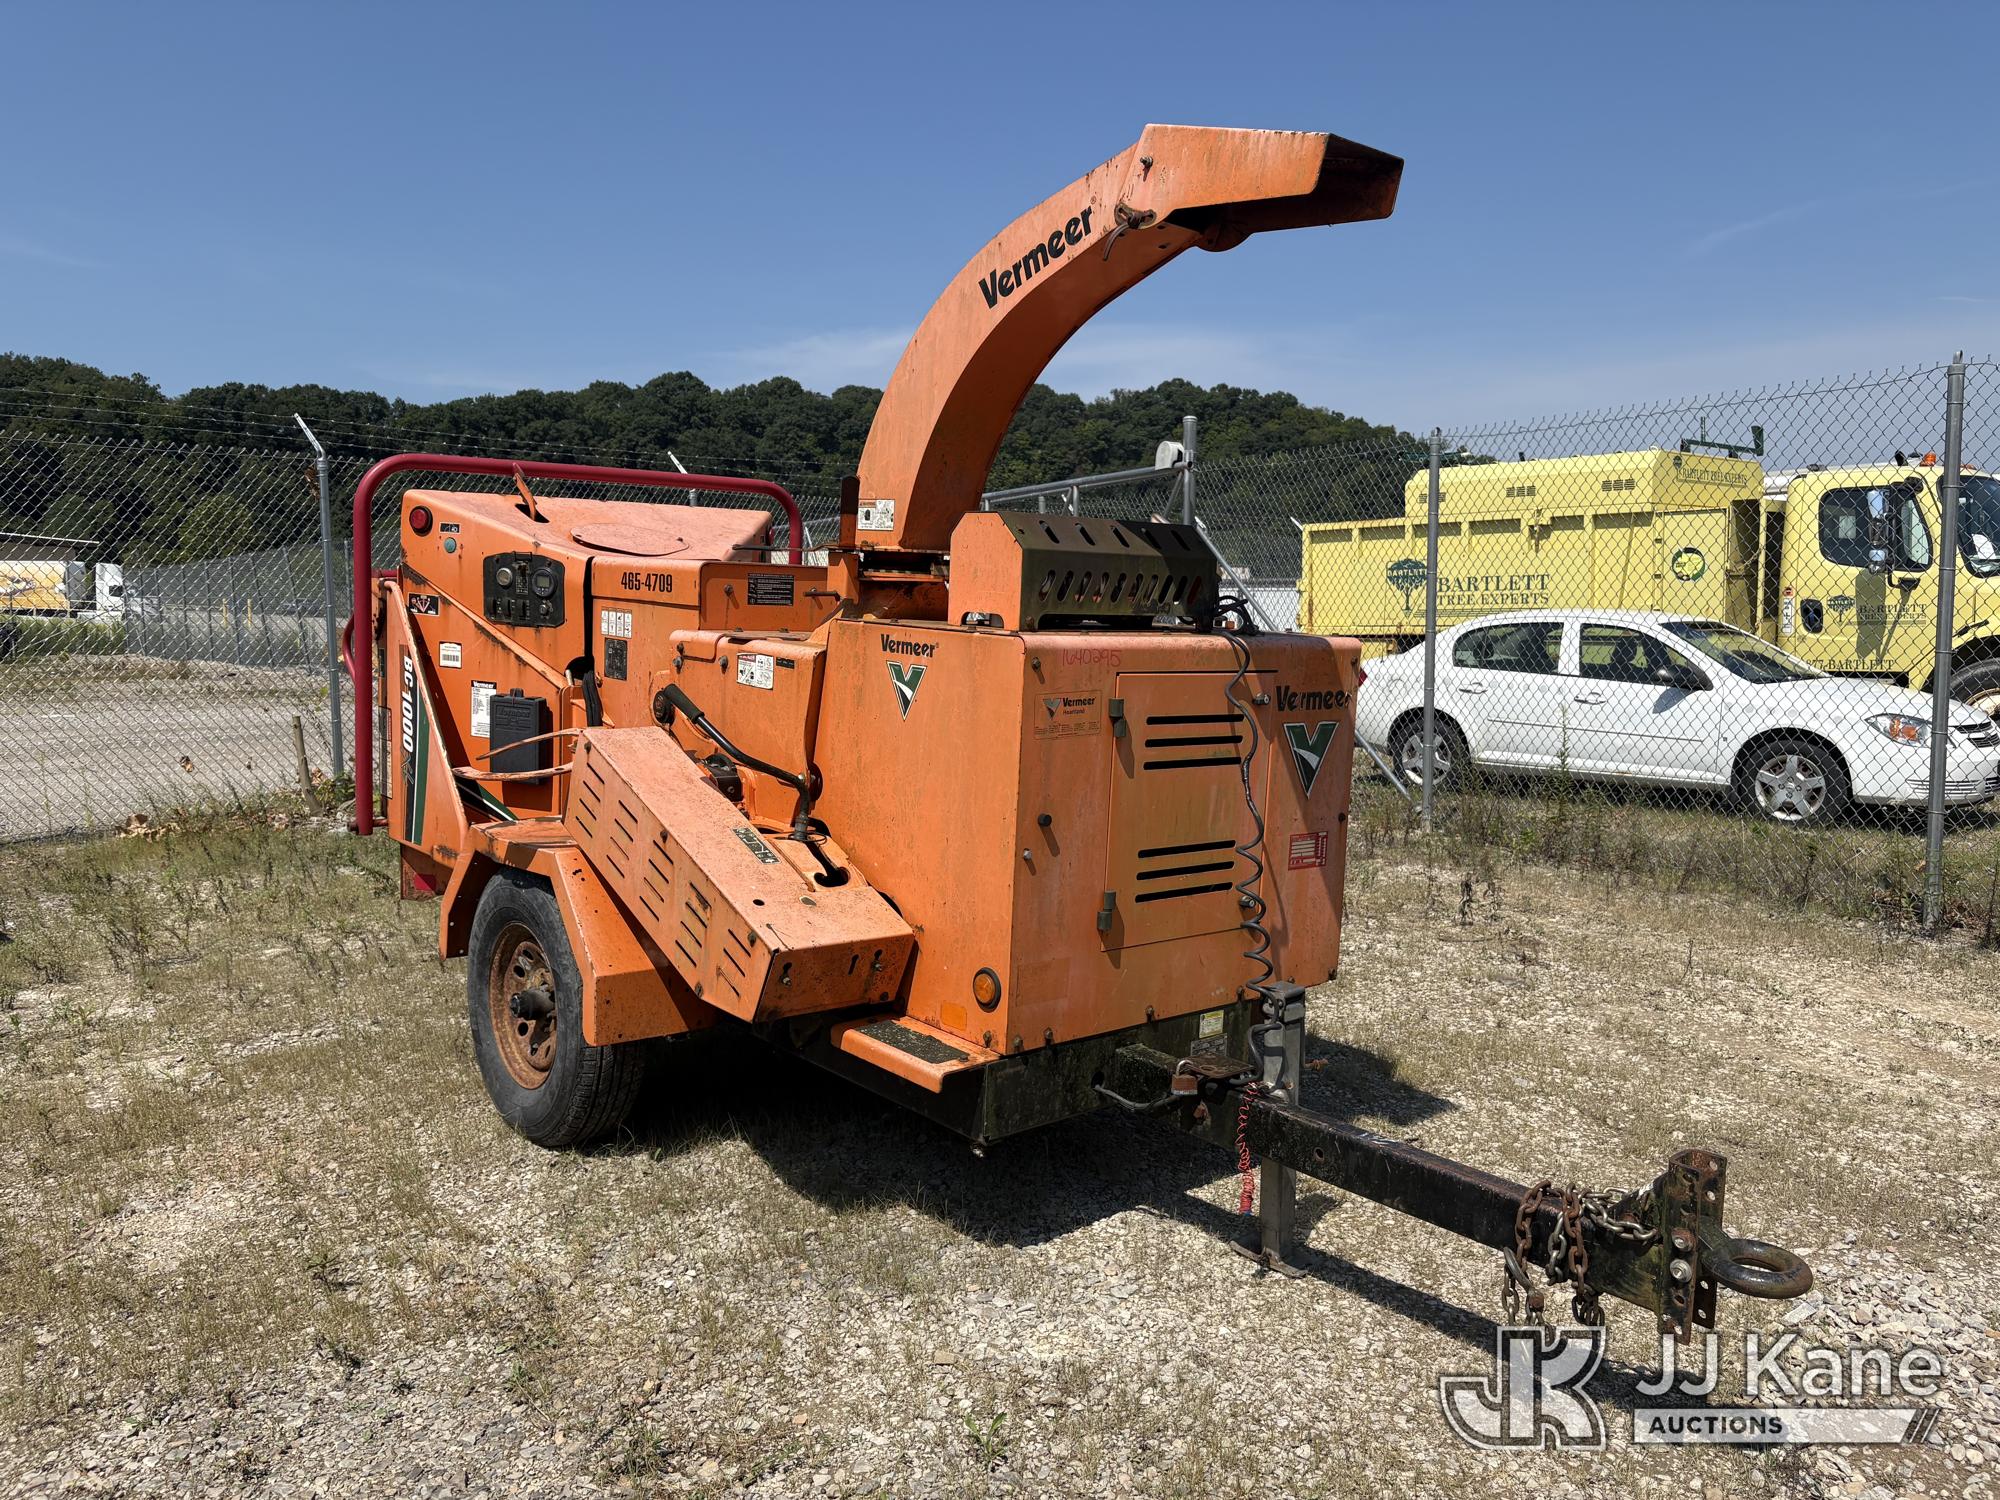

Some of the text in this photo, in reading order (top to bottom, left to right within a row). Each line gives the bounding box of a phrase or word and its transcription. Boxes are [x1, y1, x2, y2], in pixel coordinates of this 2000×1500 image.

[979, 206, 1092, 309] Vermeer
[621, 572, 672, 592] 465-4709
[1437, 574, 1549, 592] BARTLETT
[1437, 593, 1549, 606] TREE EXPERTS
[1859, 604, 1926, 614] BARTLETT
[881, 634, 935, 658] Vermeer
[1062, 697, 1095, 707] Vermeer
[1276, 685, 1351, 711] Vermeer
